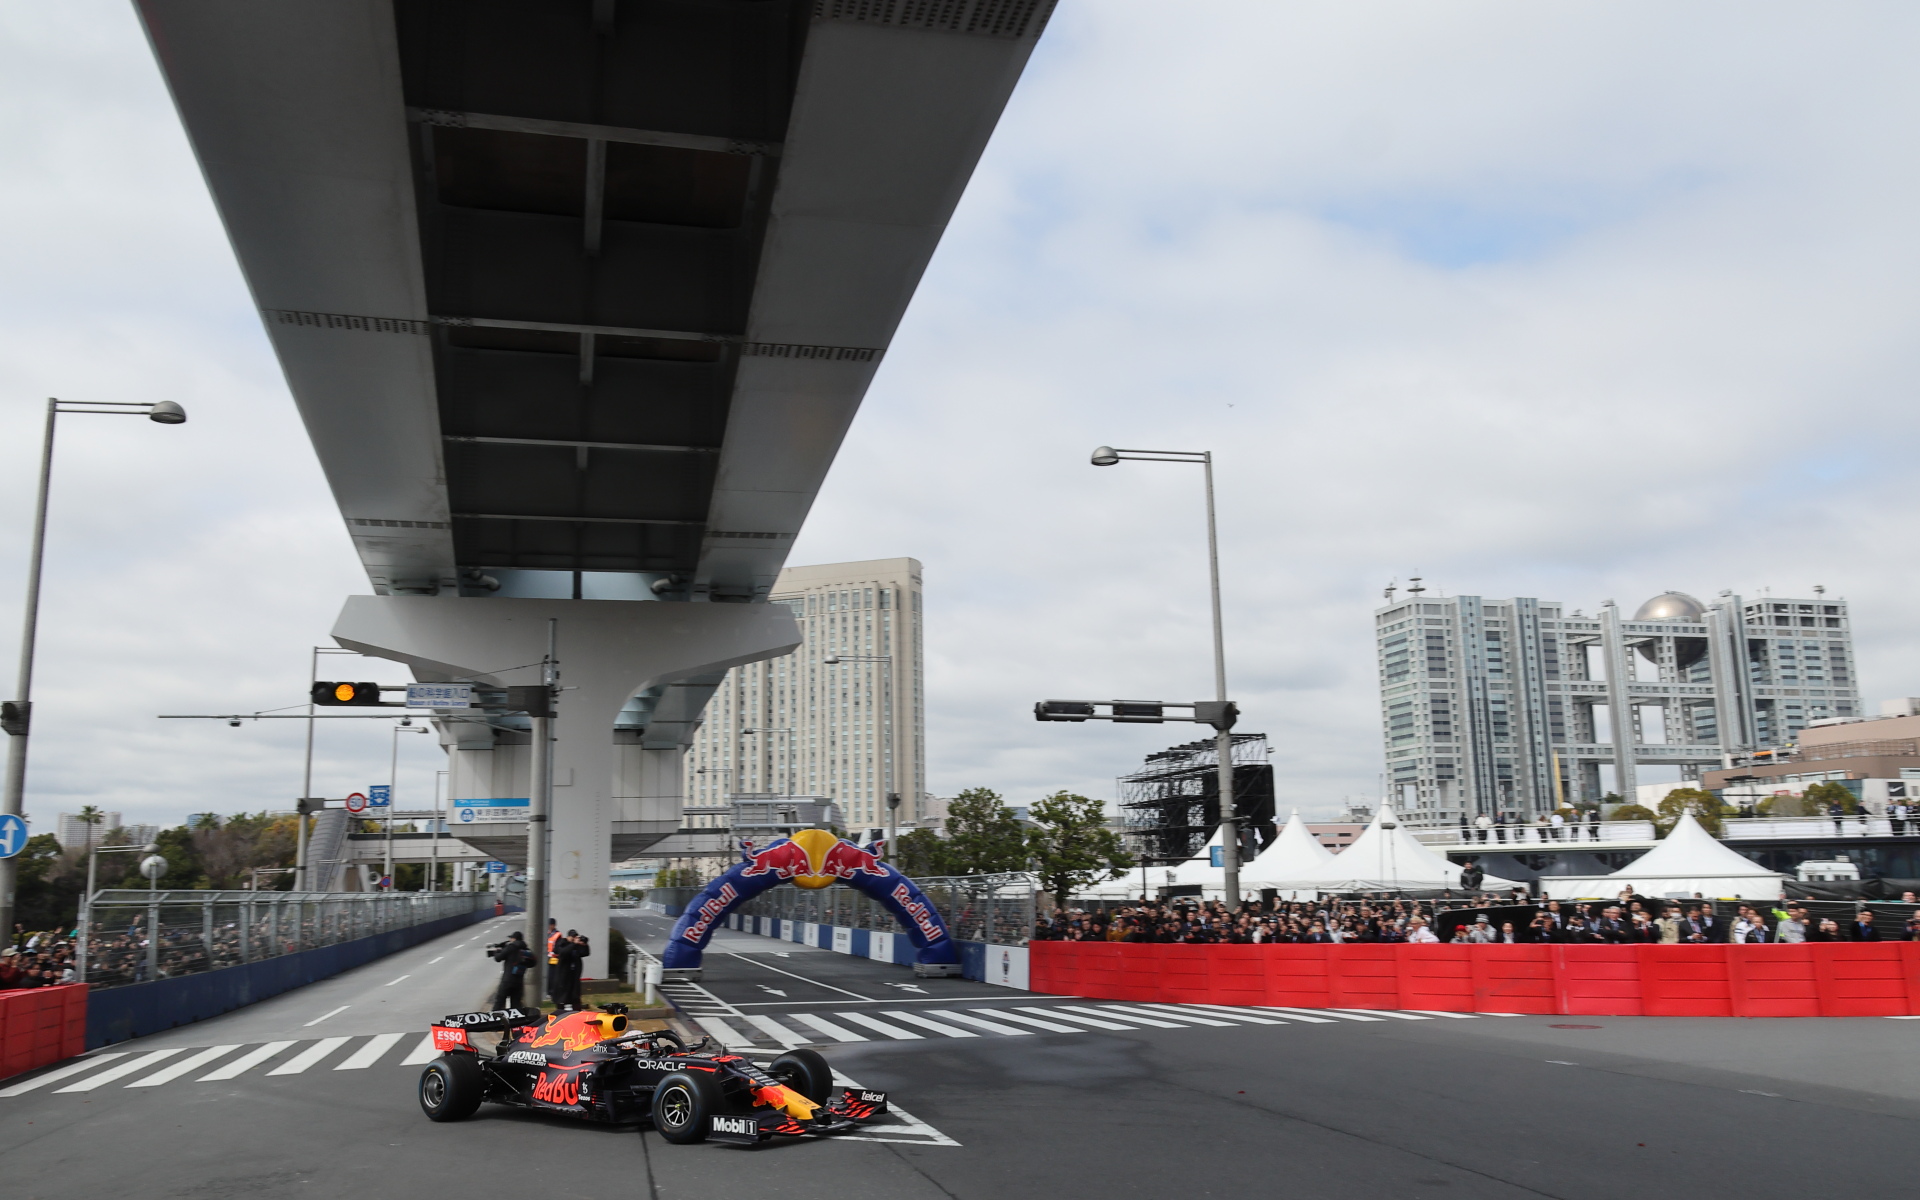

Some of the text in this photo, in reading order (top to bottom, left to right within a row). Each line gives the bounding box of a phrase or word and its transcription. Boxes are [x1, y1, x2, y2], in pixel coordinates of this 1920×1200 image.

[682, 882, 739, 943] Red Bull
[891, 882, 944, 942] Red Bull
[437, 1030, 462, 1042] ESSO
[510, 1051, 547, 1062] HONDA
[532, 1071, 559, 1102] Red
[860, 1090, 885, 1102] telcel
[712, 1116, 746, 1134] Mobil
